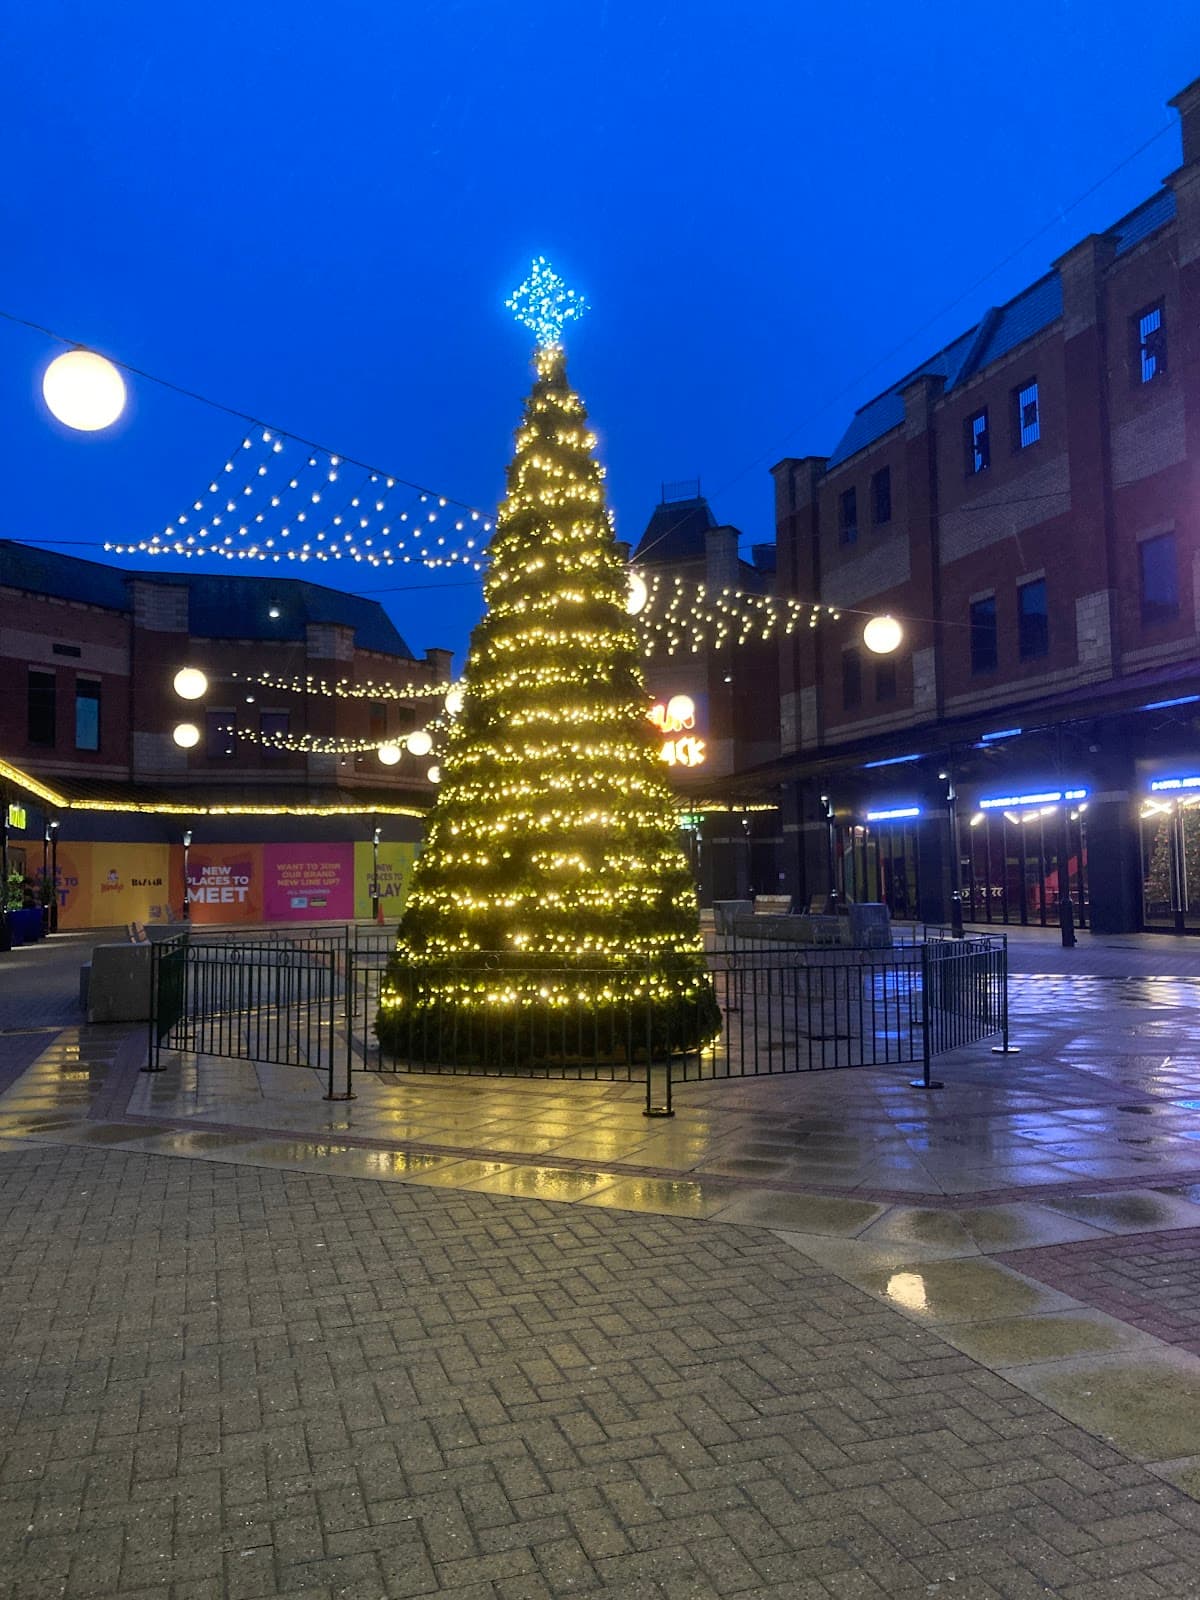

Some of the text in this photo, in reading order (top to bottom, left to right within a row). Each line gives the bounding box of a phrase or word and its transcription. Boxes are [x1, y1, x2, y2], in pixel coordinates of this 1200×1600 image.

[202, 866, 232, 875] NEW
[276, 863, 304, 871] WANT
[306, 863, 318, 871] TO
[64, 877, 79, 886] TO
[186, 876, 249, 886] PLACES TO
[277, 879, 299, 887] NEW
[368, 883, 402, 897] PLAY
[187, 886, 249, 904] MEET
